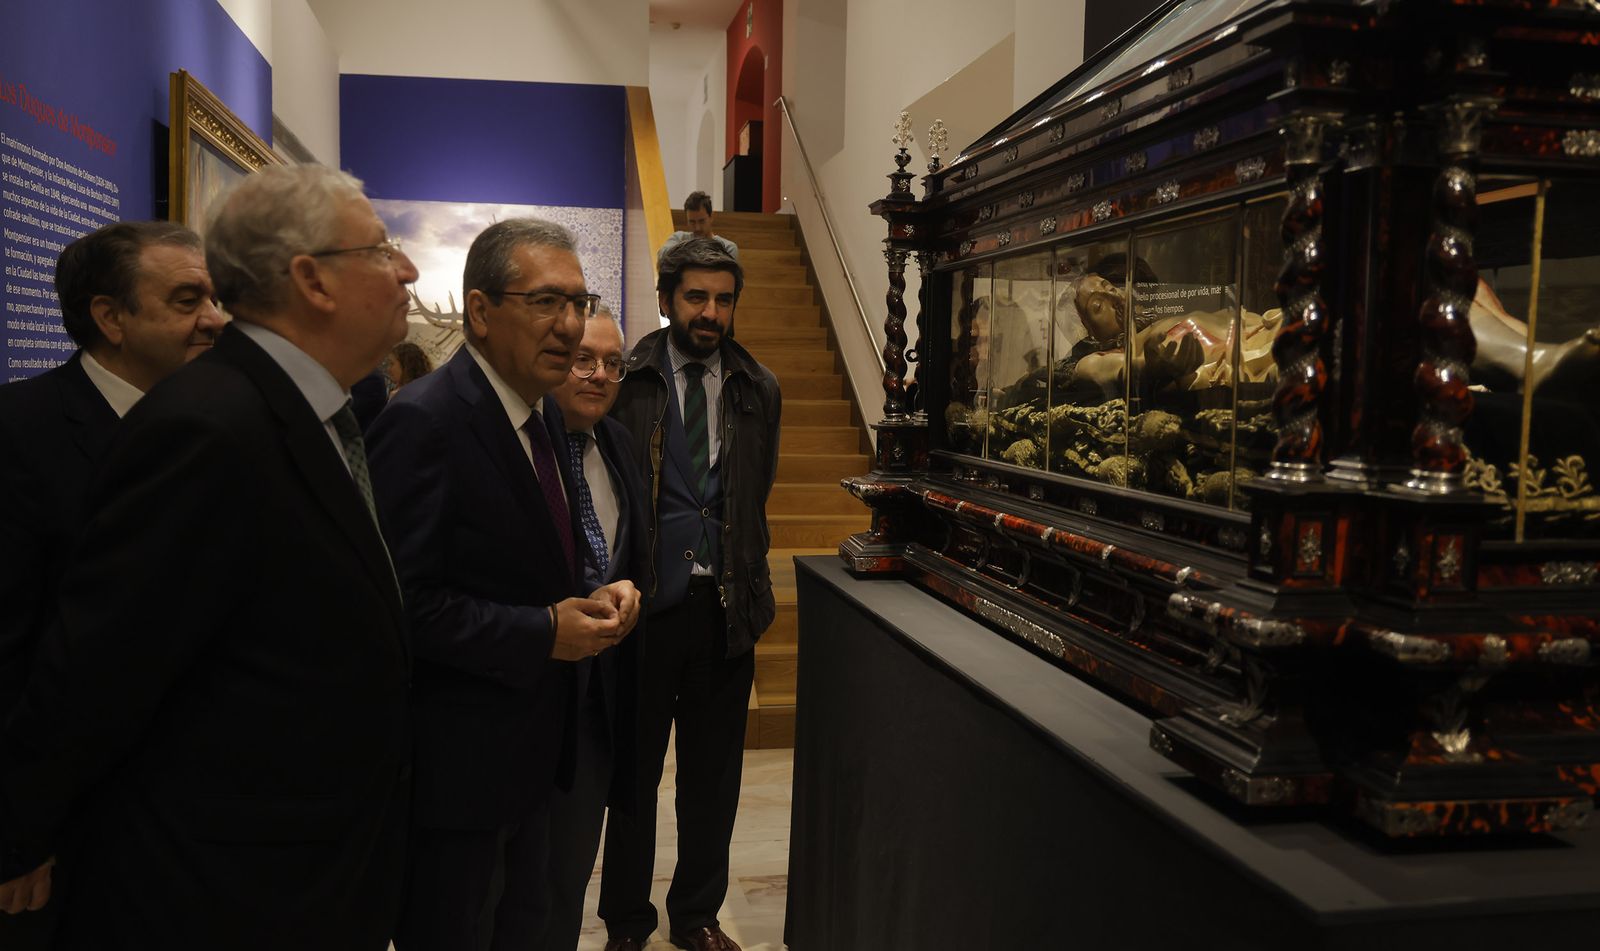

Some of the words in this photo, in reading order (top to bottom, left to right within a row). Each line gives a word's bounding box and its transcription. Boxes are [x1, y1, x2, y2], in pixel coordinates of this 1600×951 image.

[6, 137, 31, 155] matrimonio
[31, 146, 48, 163] formado
[31, 180, 45, 195] Sevilla
[3, 190, 21, 204] muchos
[4, 227, 31, 245] Montpensier
[17, 266, 33, 279] Ciudad
[1150, 287, 1180, 302] procesional
[1180, 287, 1187, 299] de
[1187, 287, 1197, 300] por
[1163, 303, 1185, 315] tiempos.
[8, 357, 22, 368] Como
